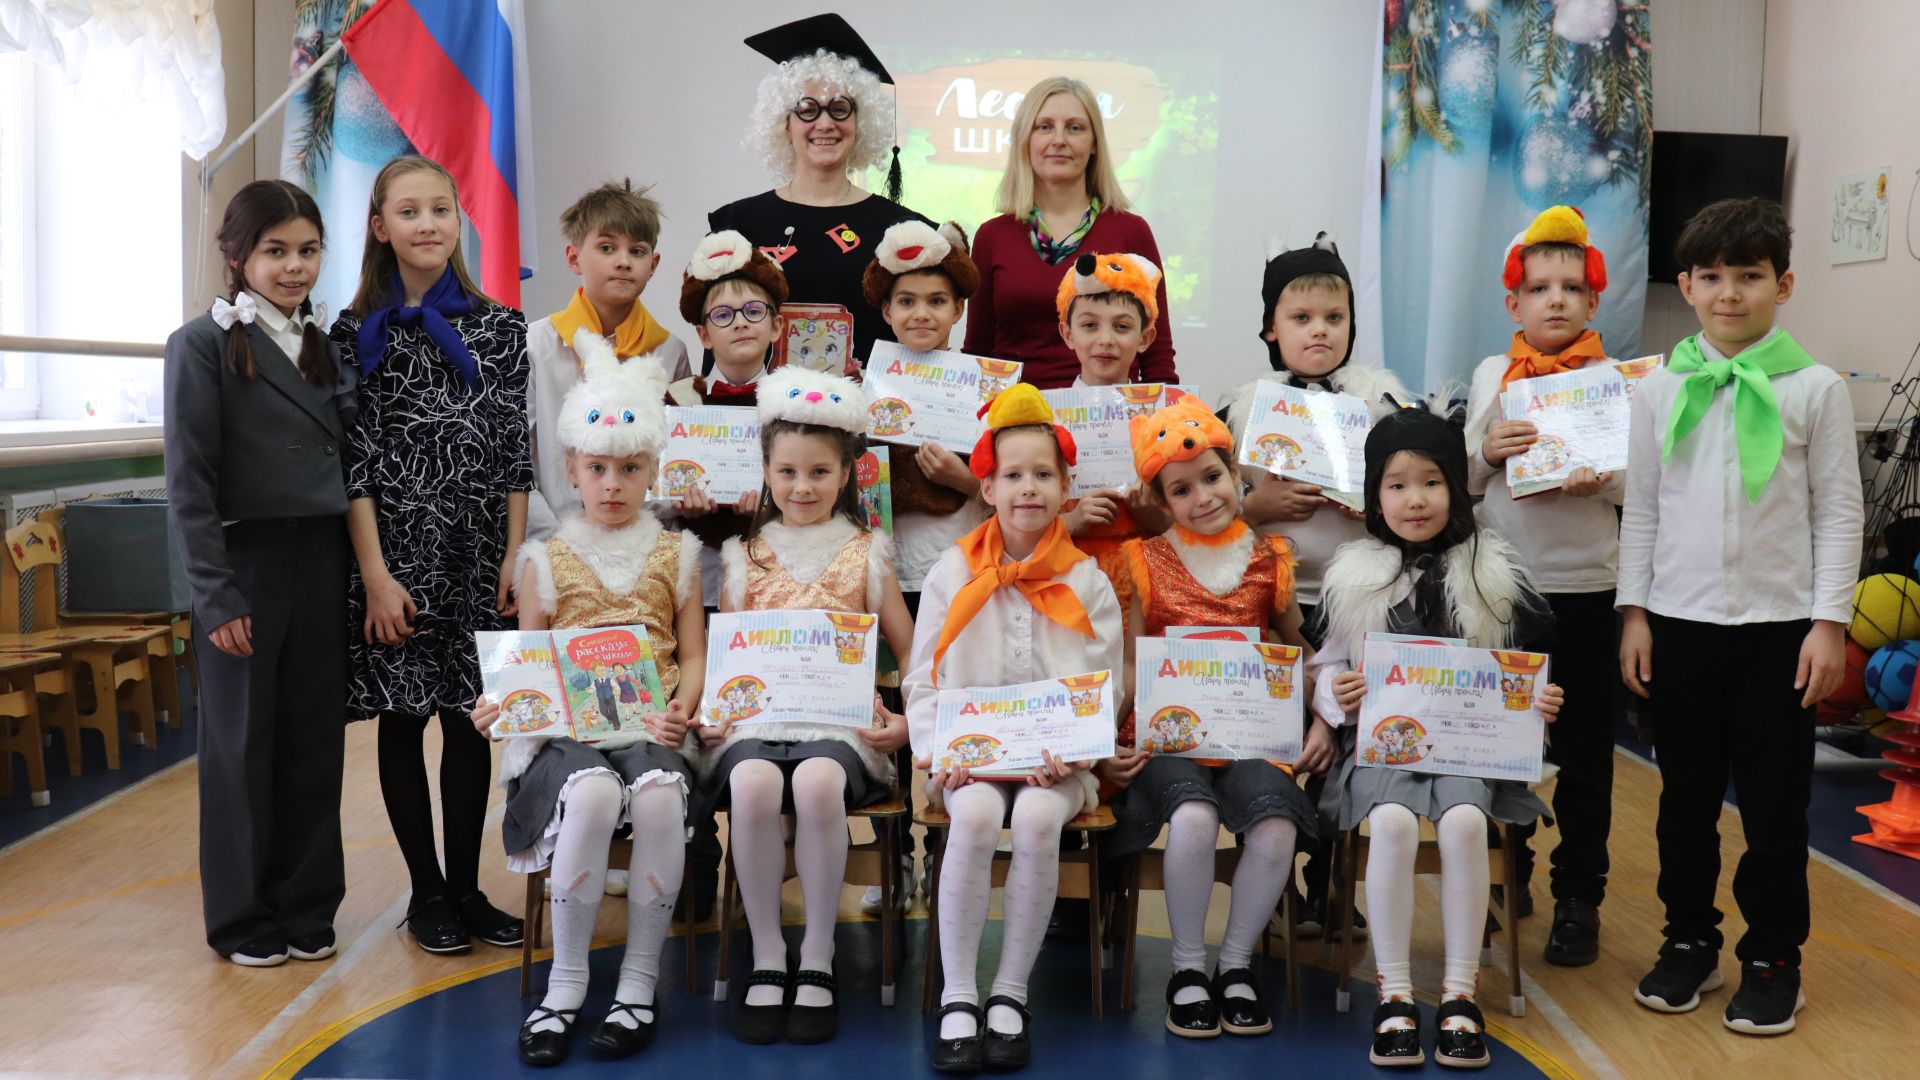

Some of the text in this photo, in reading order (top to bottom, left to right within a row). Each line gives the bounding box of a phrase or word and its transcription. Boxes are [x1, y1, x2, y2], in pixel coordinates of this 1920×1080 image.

[936, 77, 1126, 120] Леся
[886, 359, 977, 387] ДИПЛОМ
[1527, 382, 1621, 412] ДИПЛОМ
[671, 422, 762, 439] ДИПЛОМ
[729, 628, 831, 650] ДИПЛОМ
[1158, 658, 1261, 680] ДИПЛОМ
[1385, 664, 1496, 690] ДИПЛОМ
[960, 693, 1066, 716] ДИПЛОМ
